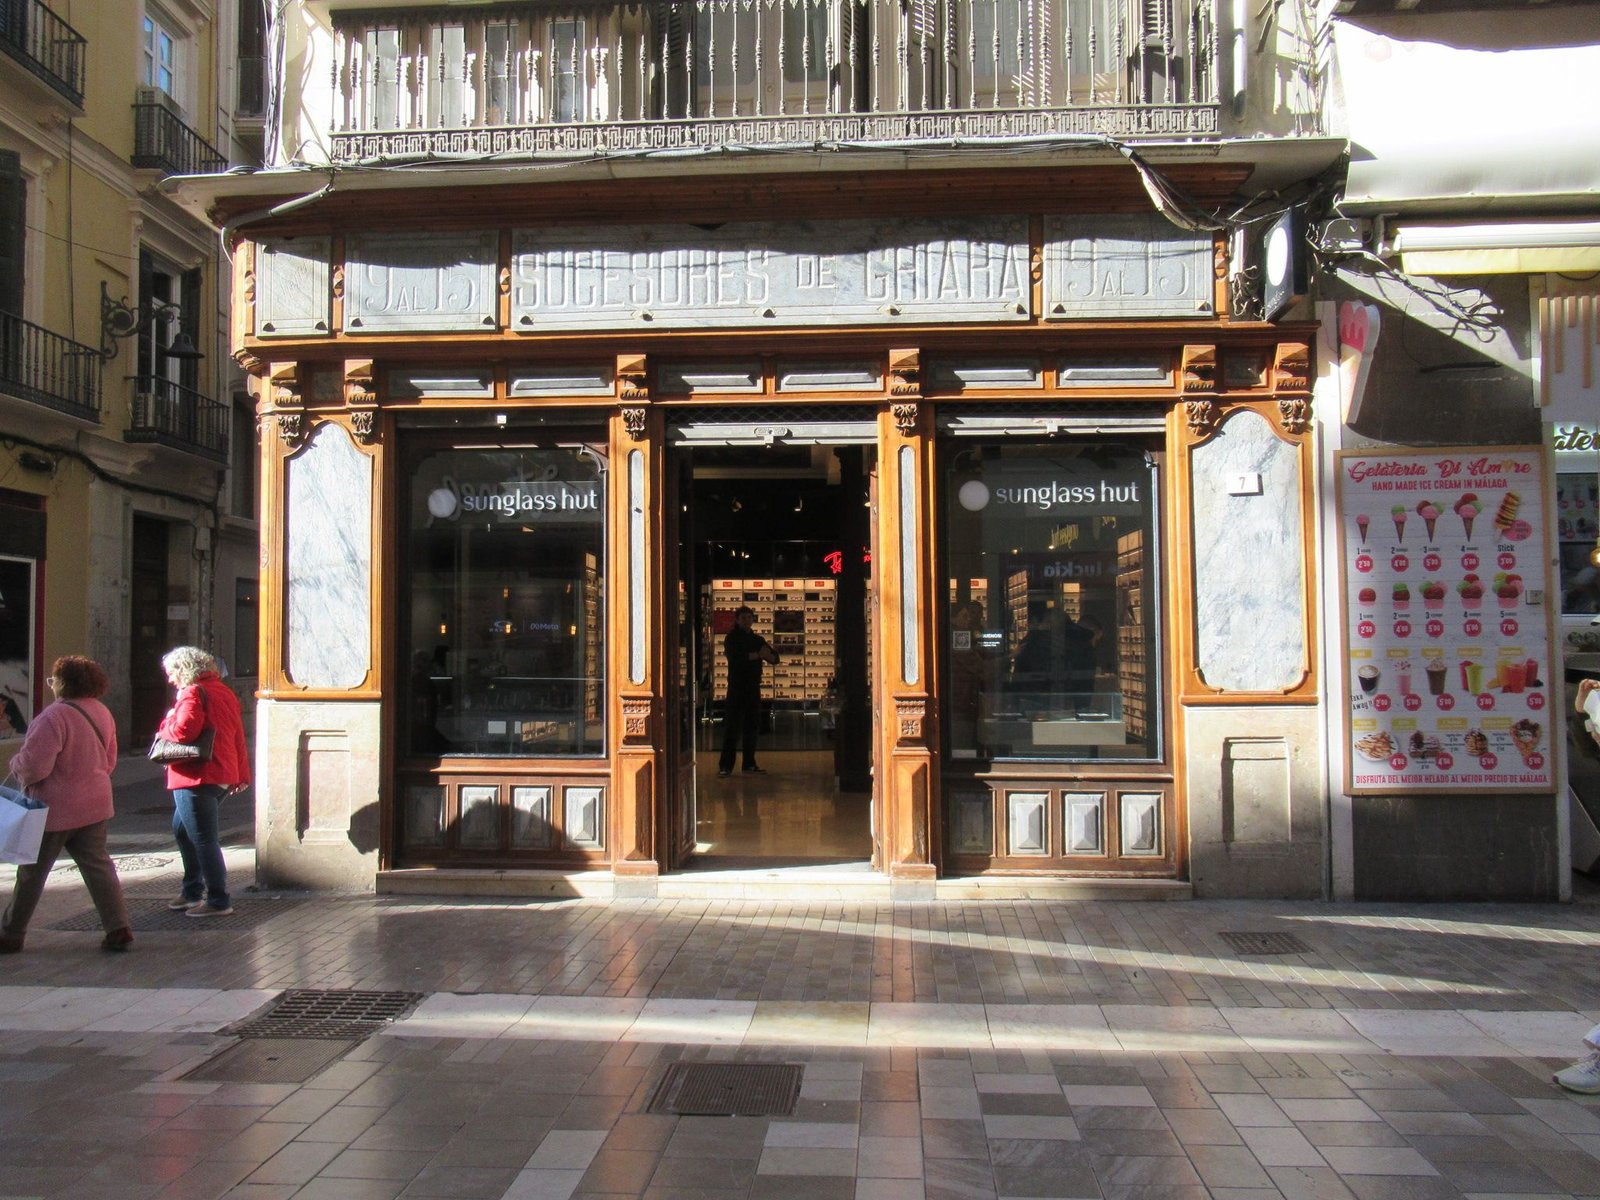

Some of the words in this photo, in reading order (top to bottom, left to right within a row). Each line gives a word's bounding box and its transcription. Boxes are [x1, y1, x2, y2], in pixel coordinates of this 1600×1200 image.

[797, 254, 836, 290] DE
[1102, 271, 1136, 297] AL
[1348, 461, 1428, 483] Gelateria
[1434, 460, 1462, 478] Di
[996, 481, 1095, 510] sunglass
[1100, 480, 1140, 502] hut
[1239, 477, 1246, 490] 7
[1372, 481, 1393, 491] HAND
[1396, 481, 1417, 490] MADE
[1420, 480, 1432, 490] ICE
[1434, 480, 1461, 489] CREAM
[1464, 479, 1473, 489] IN
[1474, 476, 1508, 489] MÁLAGA
[463, 488, 557, 517] sunglass
[561, 488, 598, 510] hut
[1497, 544, 1515, 552] Stick
[1356, 775, 1386, 784] DISFRUTA
[1388, 775, 1400, 784] DEL
[1401, 775, 1423, 783] MEJOR
[1425, 775, 1449, 783] HELADO
[1451, 775, 1459, 783] AL
[1461, 775, 1483, 783] MEJOR
[1485, 774, 1507, 783] PRECIO
[1509, 774, 1518, 783] DE
